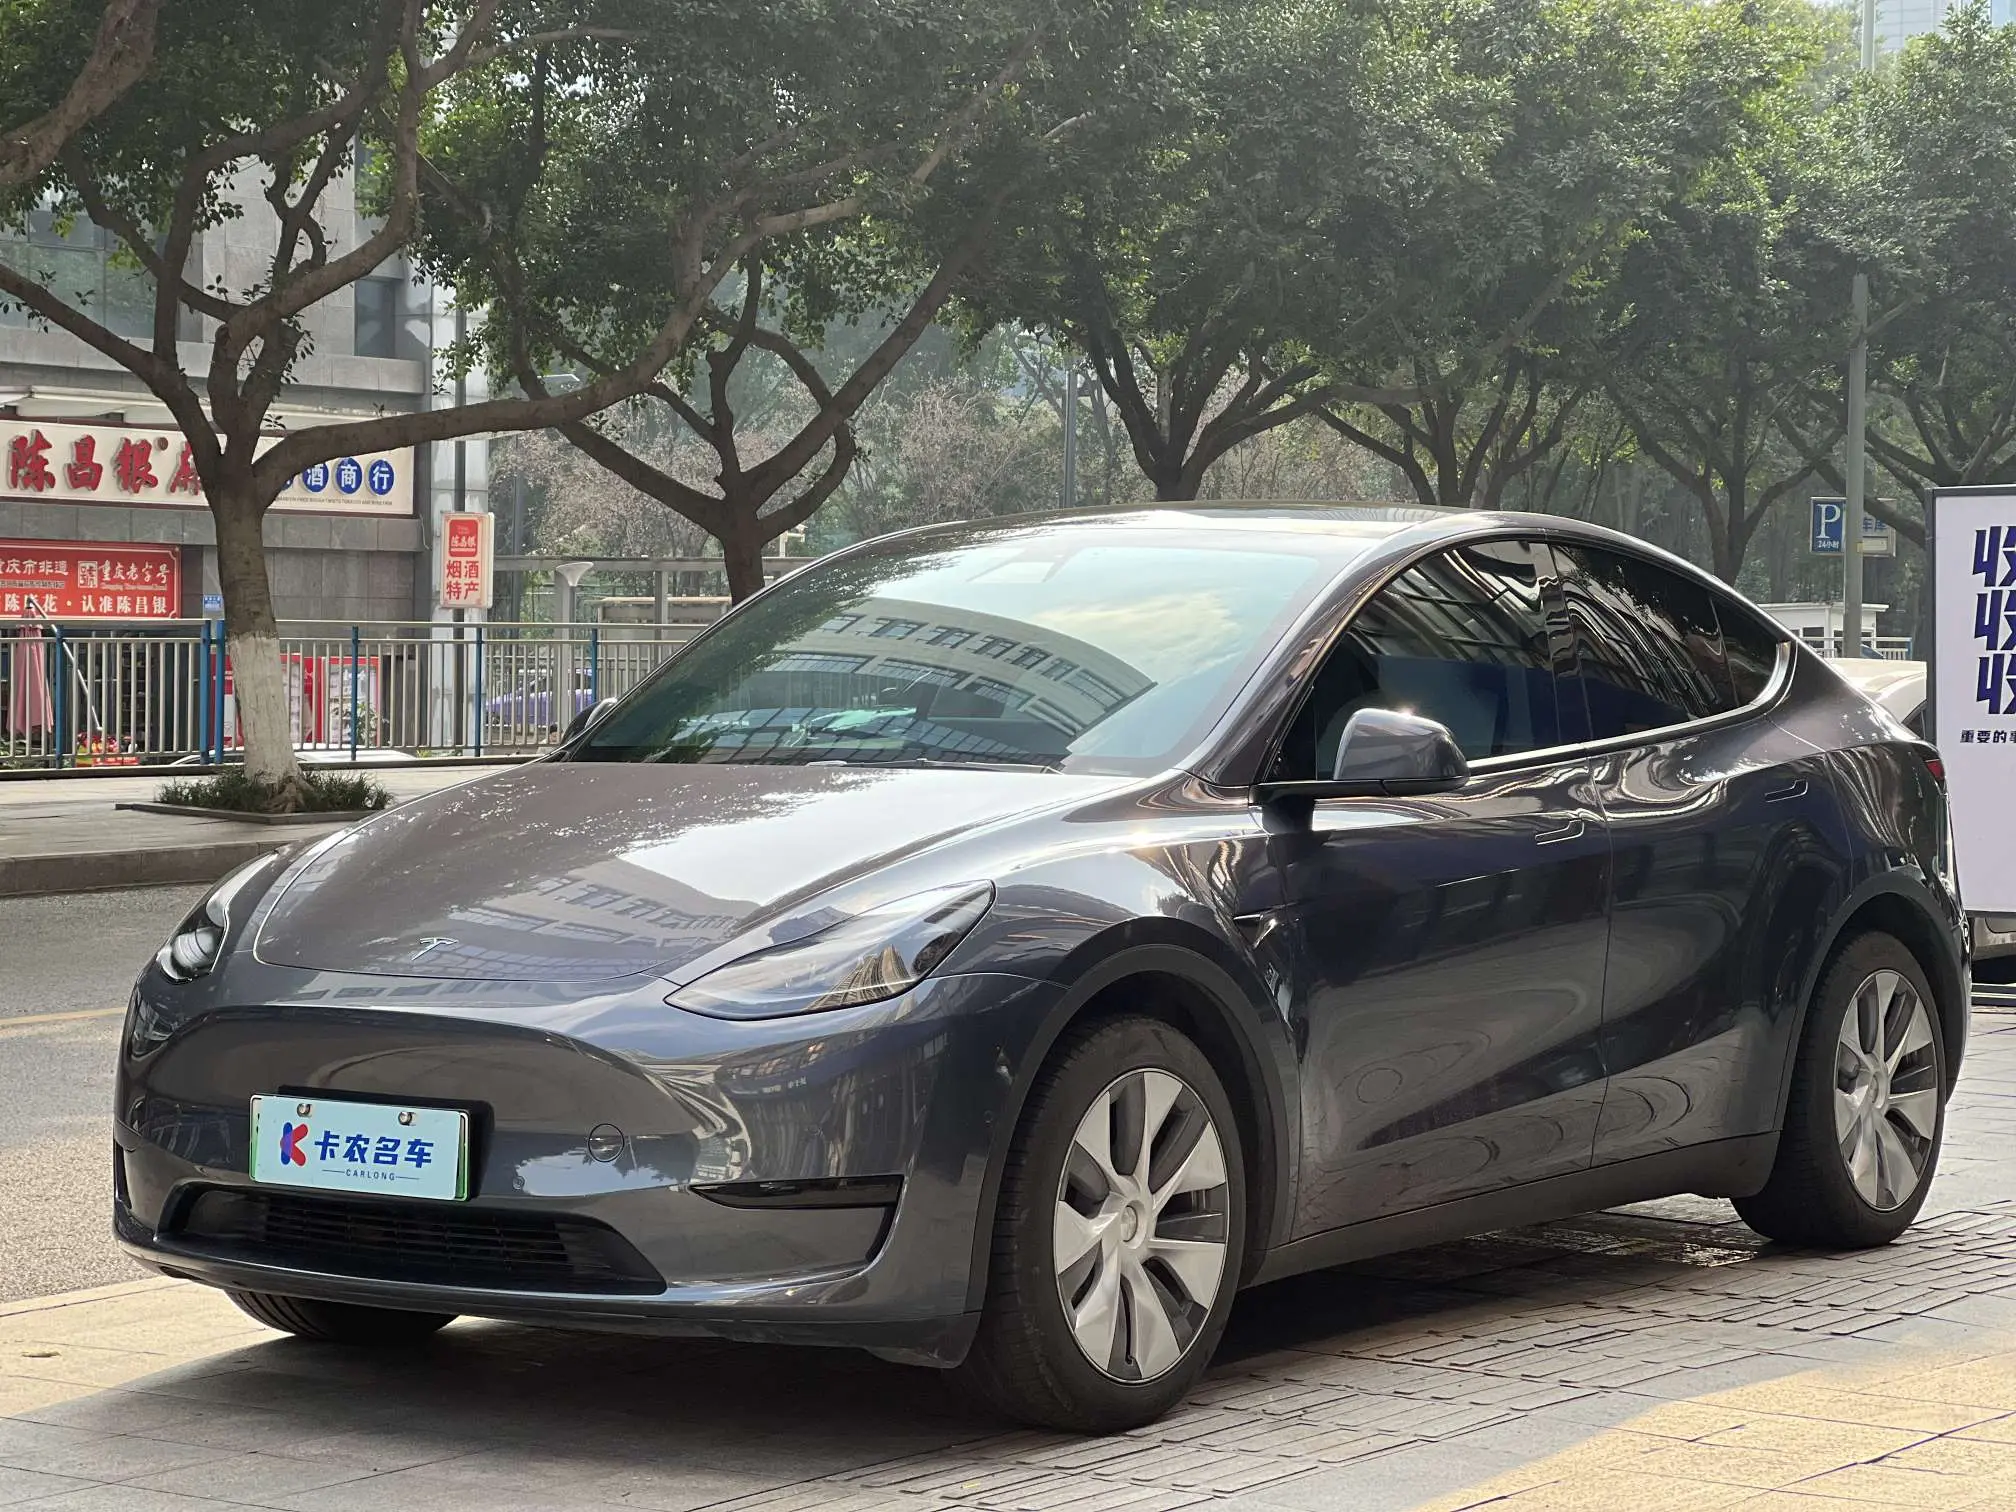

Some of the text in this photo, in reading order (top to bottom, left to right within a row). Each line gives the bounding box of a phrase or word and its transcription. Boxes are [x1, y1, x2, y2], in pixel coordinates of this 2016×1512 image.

[1816, 504, 1840, 538] P
[98, 560, 170, 584] 重庆老字号
[446, 560, 479, 578] 烟酒
[446, 580, 479, 600] 特产
[314, 1130, 434, 1168] 卡农名车
[345, 1168, 395, 1181] CARLONG
